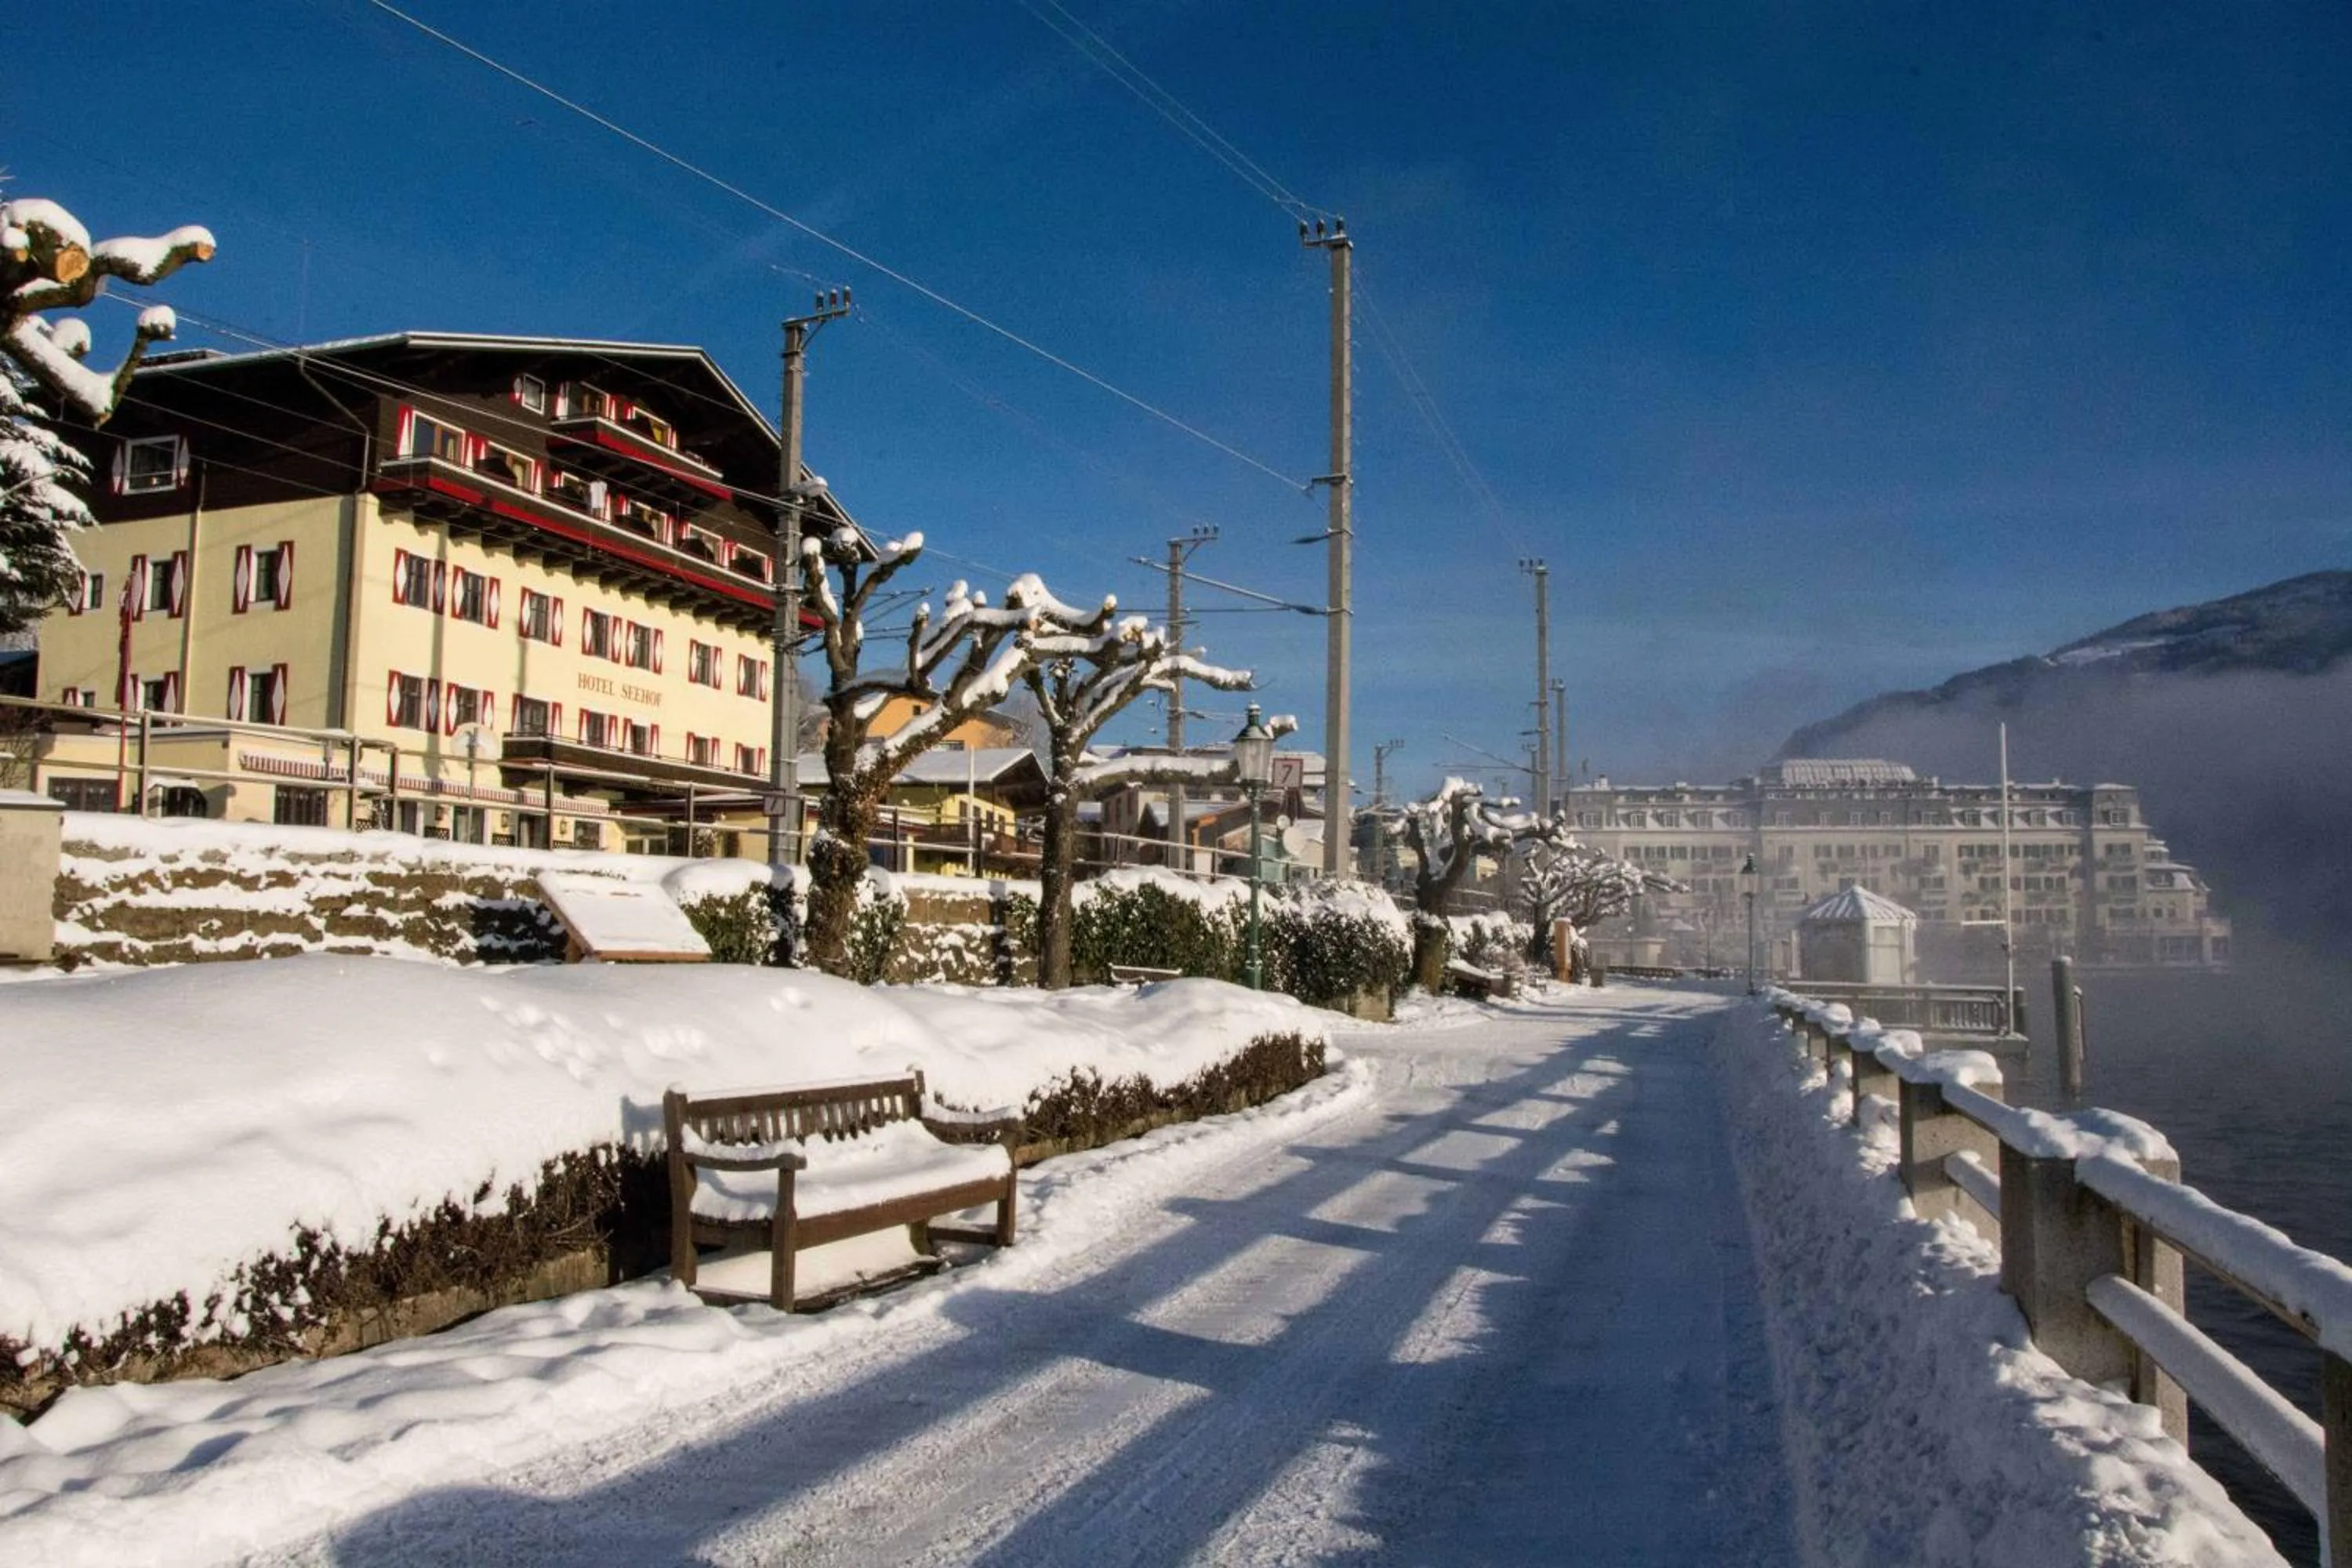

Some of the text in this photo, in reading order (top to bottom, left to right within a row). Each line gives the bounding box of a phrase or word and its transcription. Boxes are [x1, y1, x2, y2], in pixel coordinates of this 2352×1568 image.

[578, 673, 662, 706] HOTEL SEEHOF
[1282, 764, 1293, 784] 7
